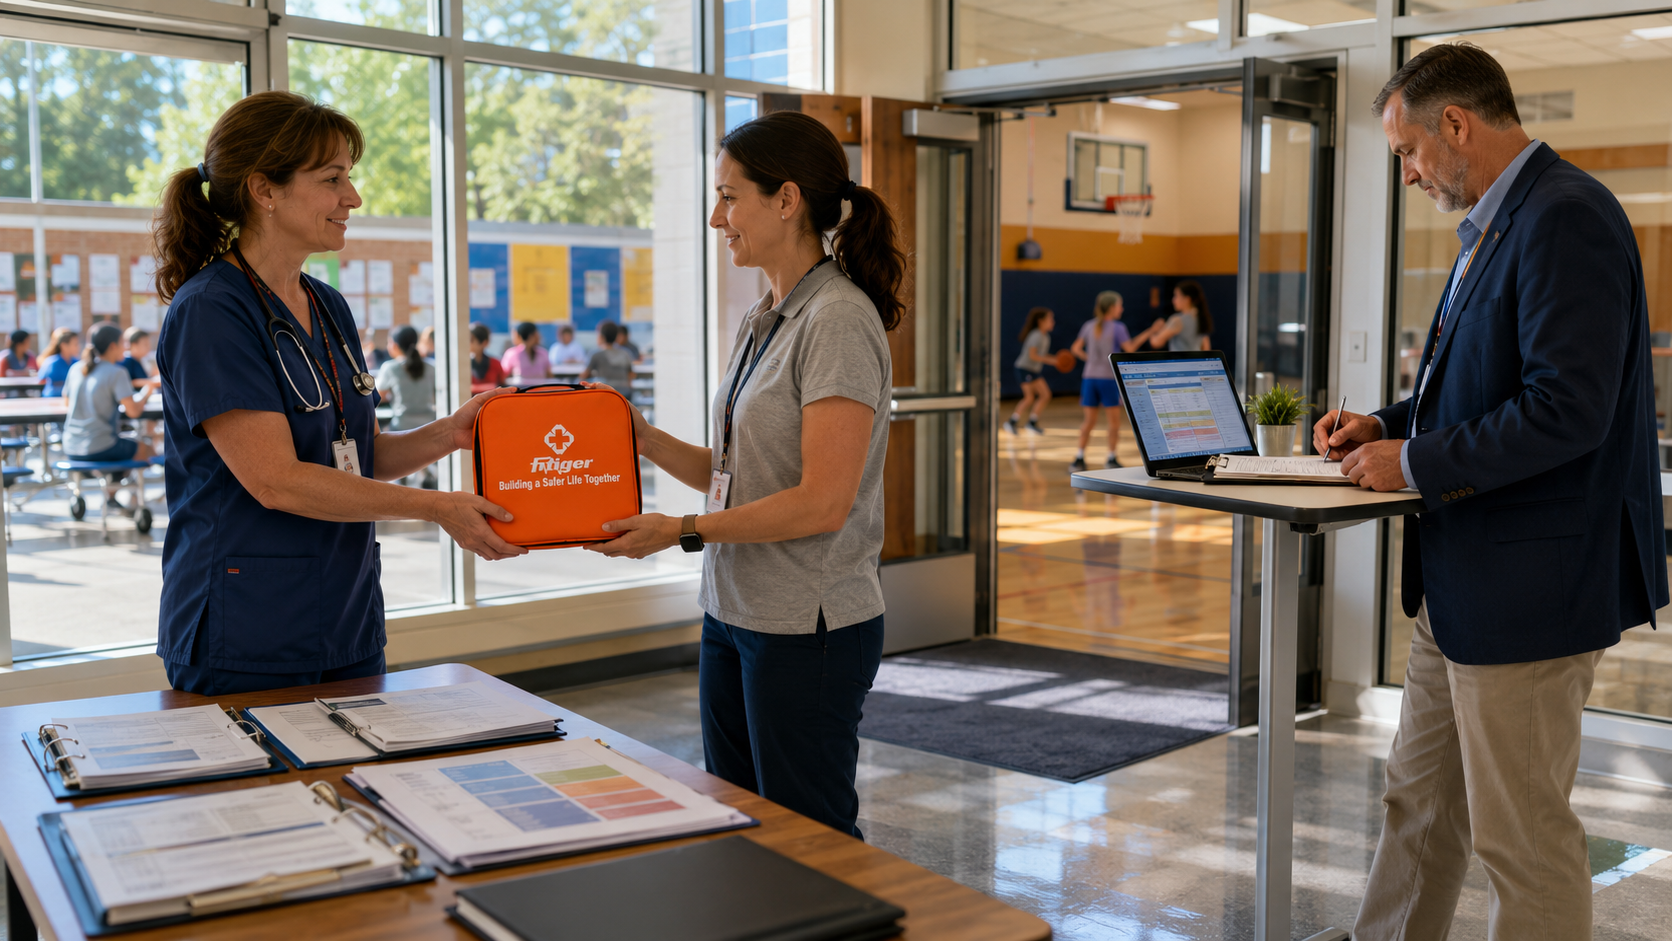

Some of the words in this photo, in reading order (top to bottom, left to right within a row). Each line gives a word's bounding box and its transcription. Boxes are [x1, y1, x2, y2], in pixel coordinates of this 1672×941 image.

[499, 480, 533, 490] Building
[535, 480, 541, 488] a
[542, 477, 565, 487] Safer
[567, 475, 583, 485] Life
[584, 473, 621, 486] Together
